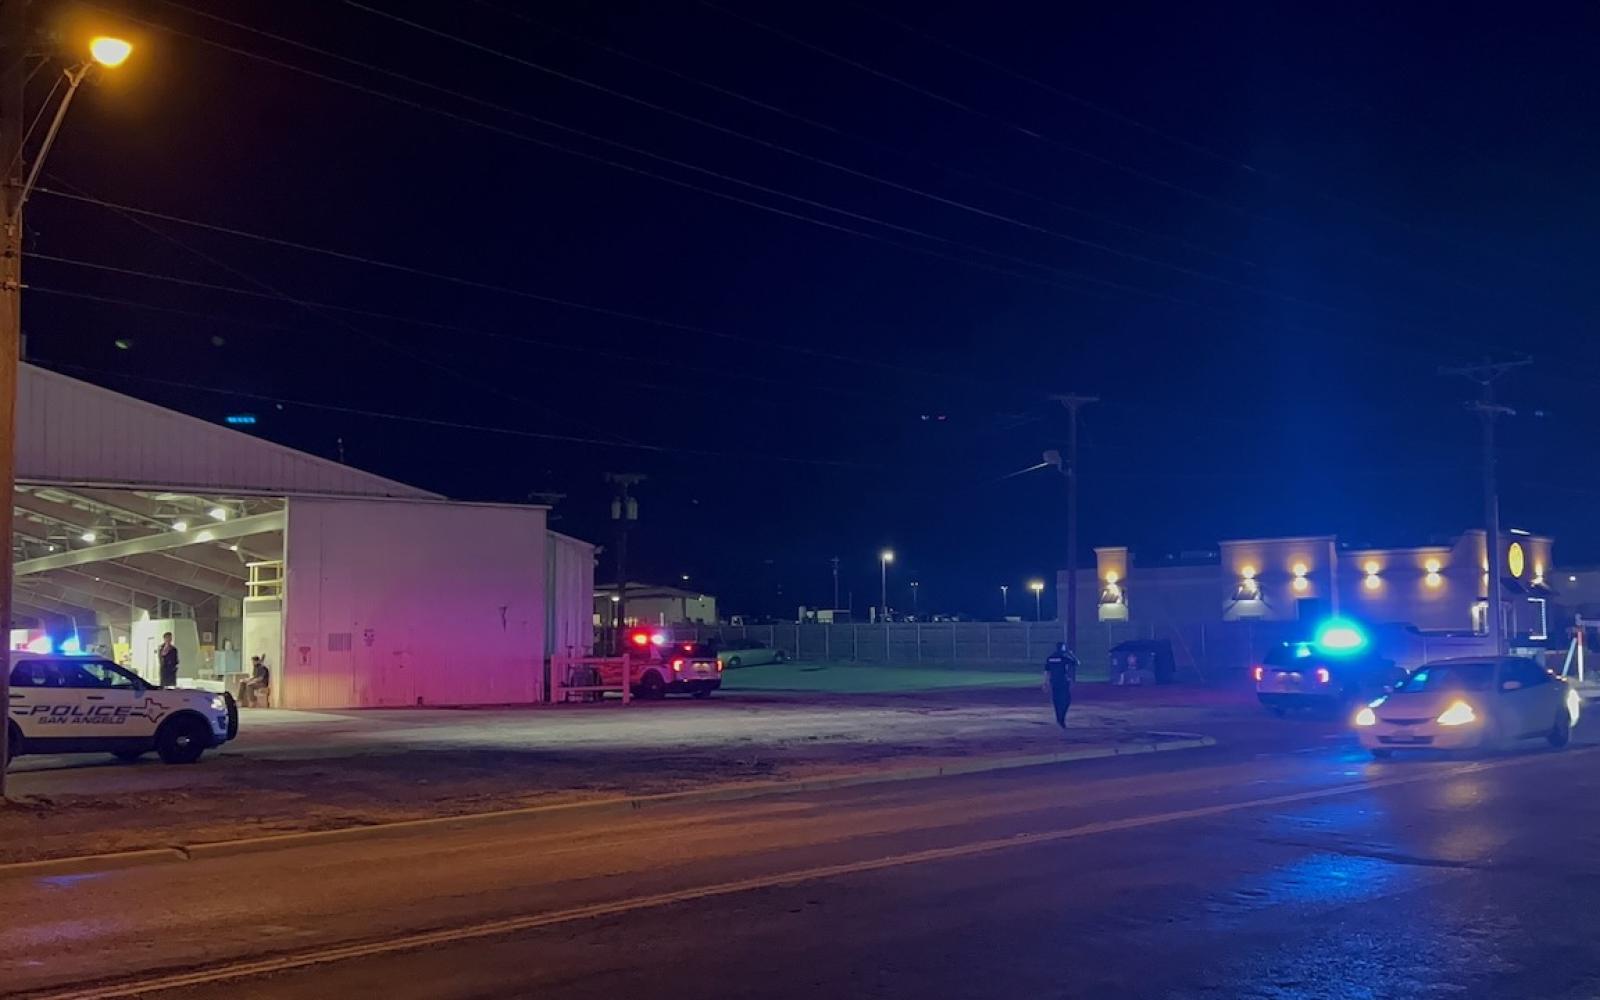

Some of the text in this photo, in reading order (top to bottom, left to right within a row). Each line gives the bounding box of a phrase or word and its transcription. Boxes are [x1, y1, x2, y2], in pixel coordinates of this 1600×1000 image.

[30, 705, 132, 716] POLICE
[38, 716, 126, 725] SAN ANGELO
